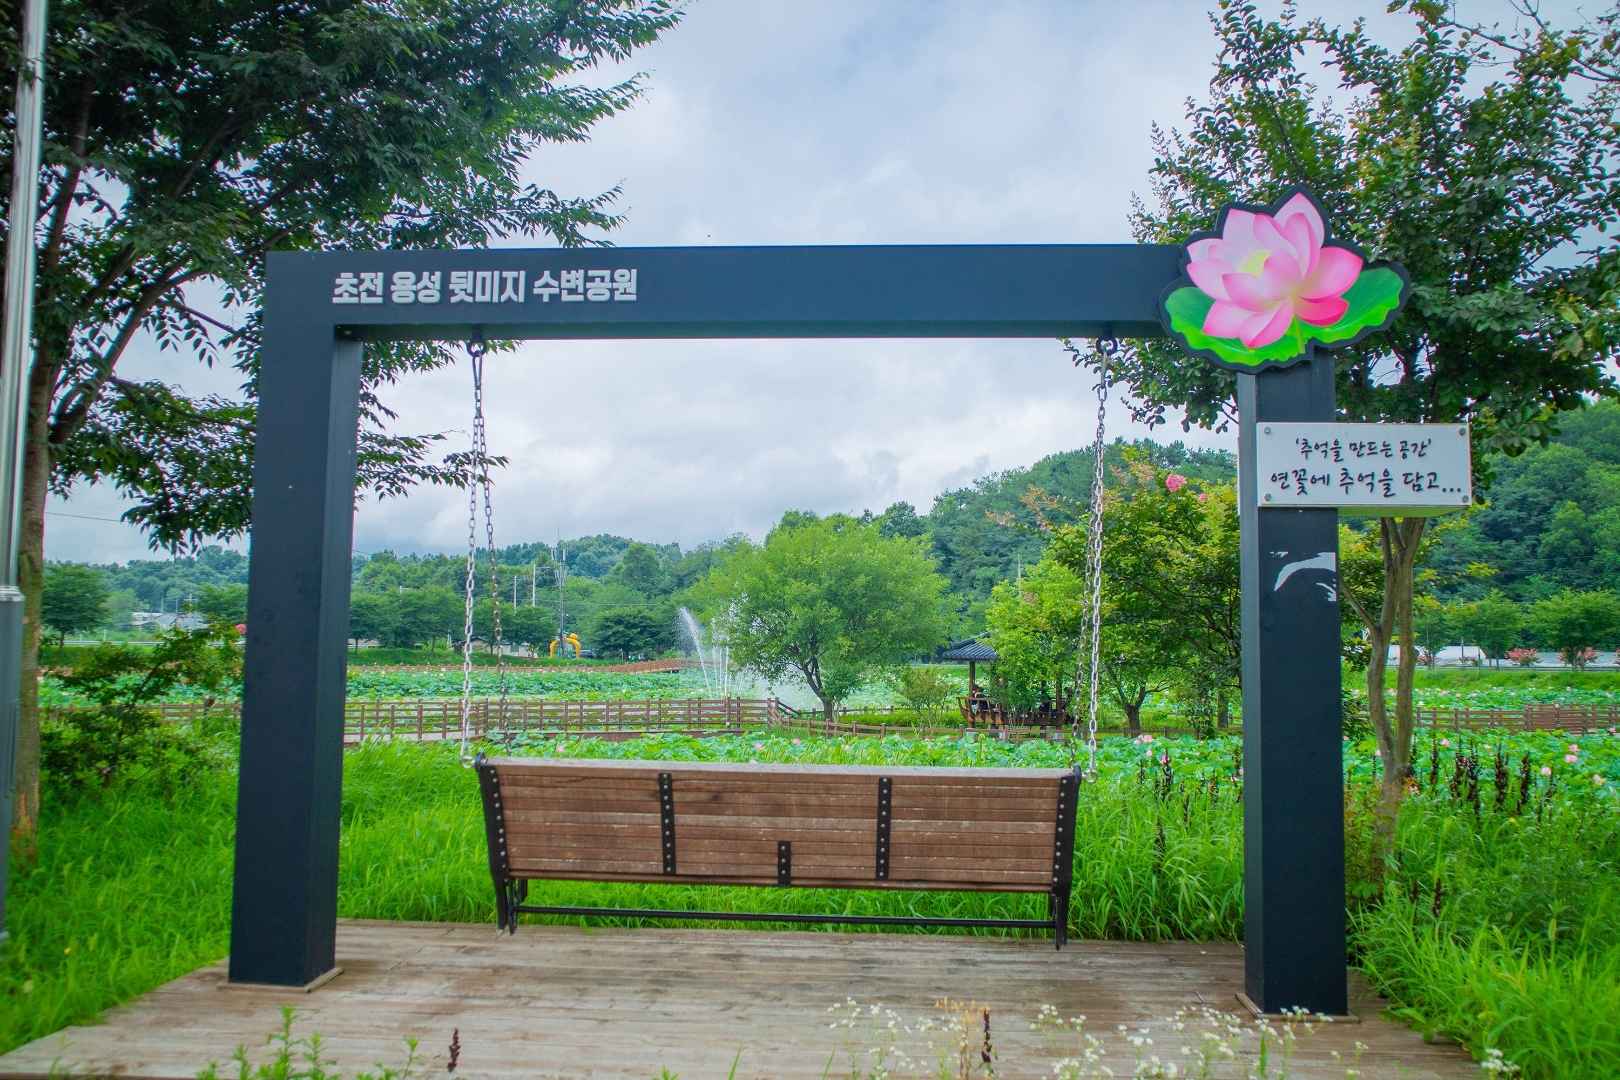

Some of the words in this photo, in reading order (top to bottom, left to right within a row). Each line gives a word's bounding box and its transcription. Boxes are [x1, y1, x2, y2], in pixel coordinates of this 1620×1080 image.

[332, 272, 384, 304] 초전
[390, 271, 441, 304] 용성
[448, 270, 526, 304] 뒷미지
[533, 268, 637, 303] 수변공원
[1349, 440, 1393, 458] 만드는
[1270, 468, 1330, 496] 연꽃에
[1339, 467, 1396, 497] 추억을
[1402, 471, 1462, 493] 담고...
